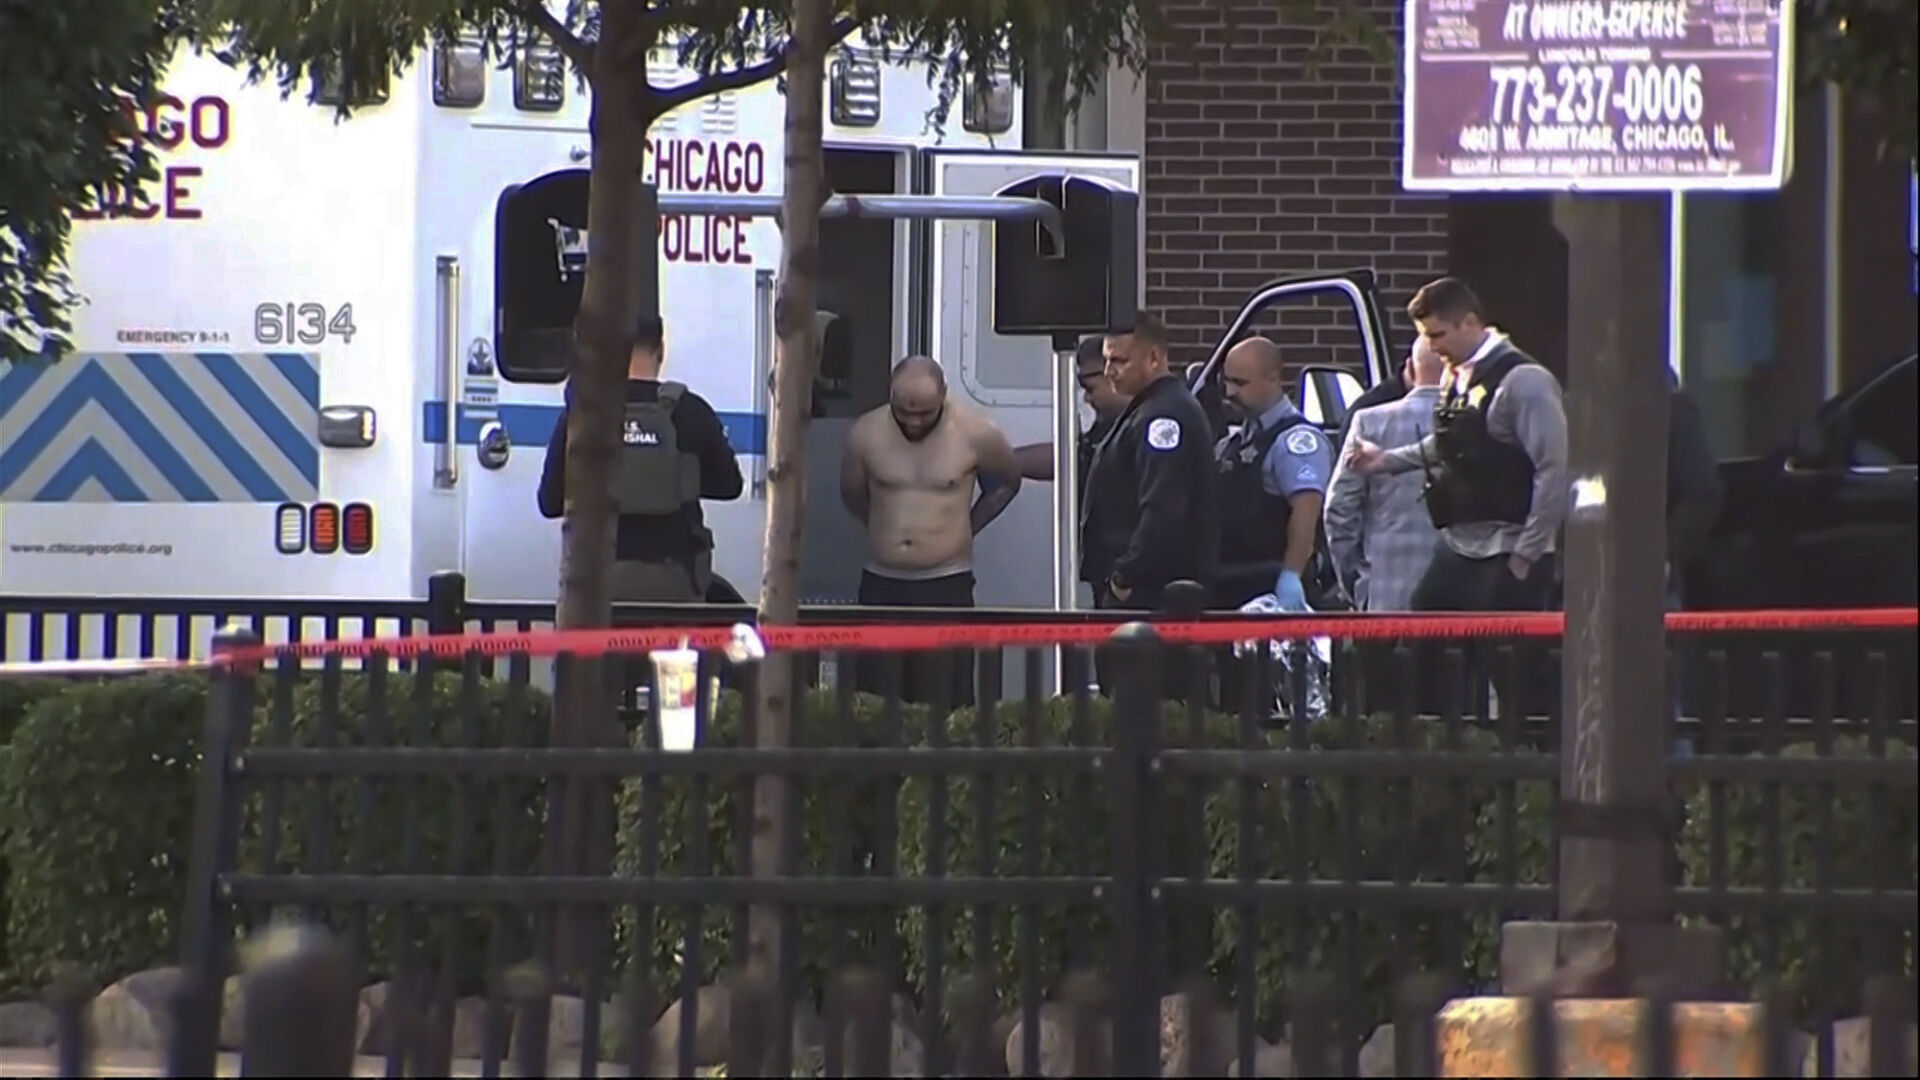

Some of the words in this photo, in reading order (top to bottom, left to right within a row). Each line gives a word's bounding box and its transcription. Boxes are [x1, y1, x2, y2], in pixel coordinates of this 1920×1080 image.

[1502, 2, 1528, 41] AT
[1490, 64, 1703, 124] 773-237-0006
[1622, 122, 1709, 156] CHICAGO,
[656, 212, 753, 264] OLICE
[116, 329, 197, 343] EMERGENCY
[254, 302, 357, 345] 6134
[10, 542, 173, 556] www.chicagopolice.org
